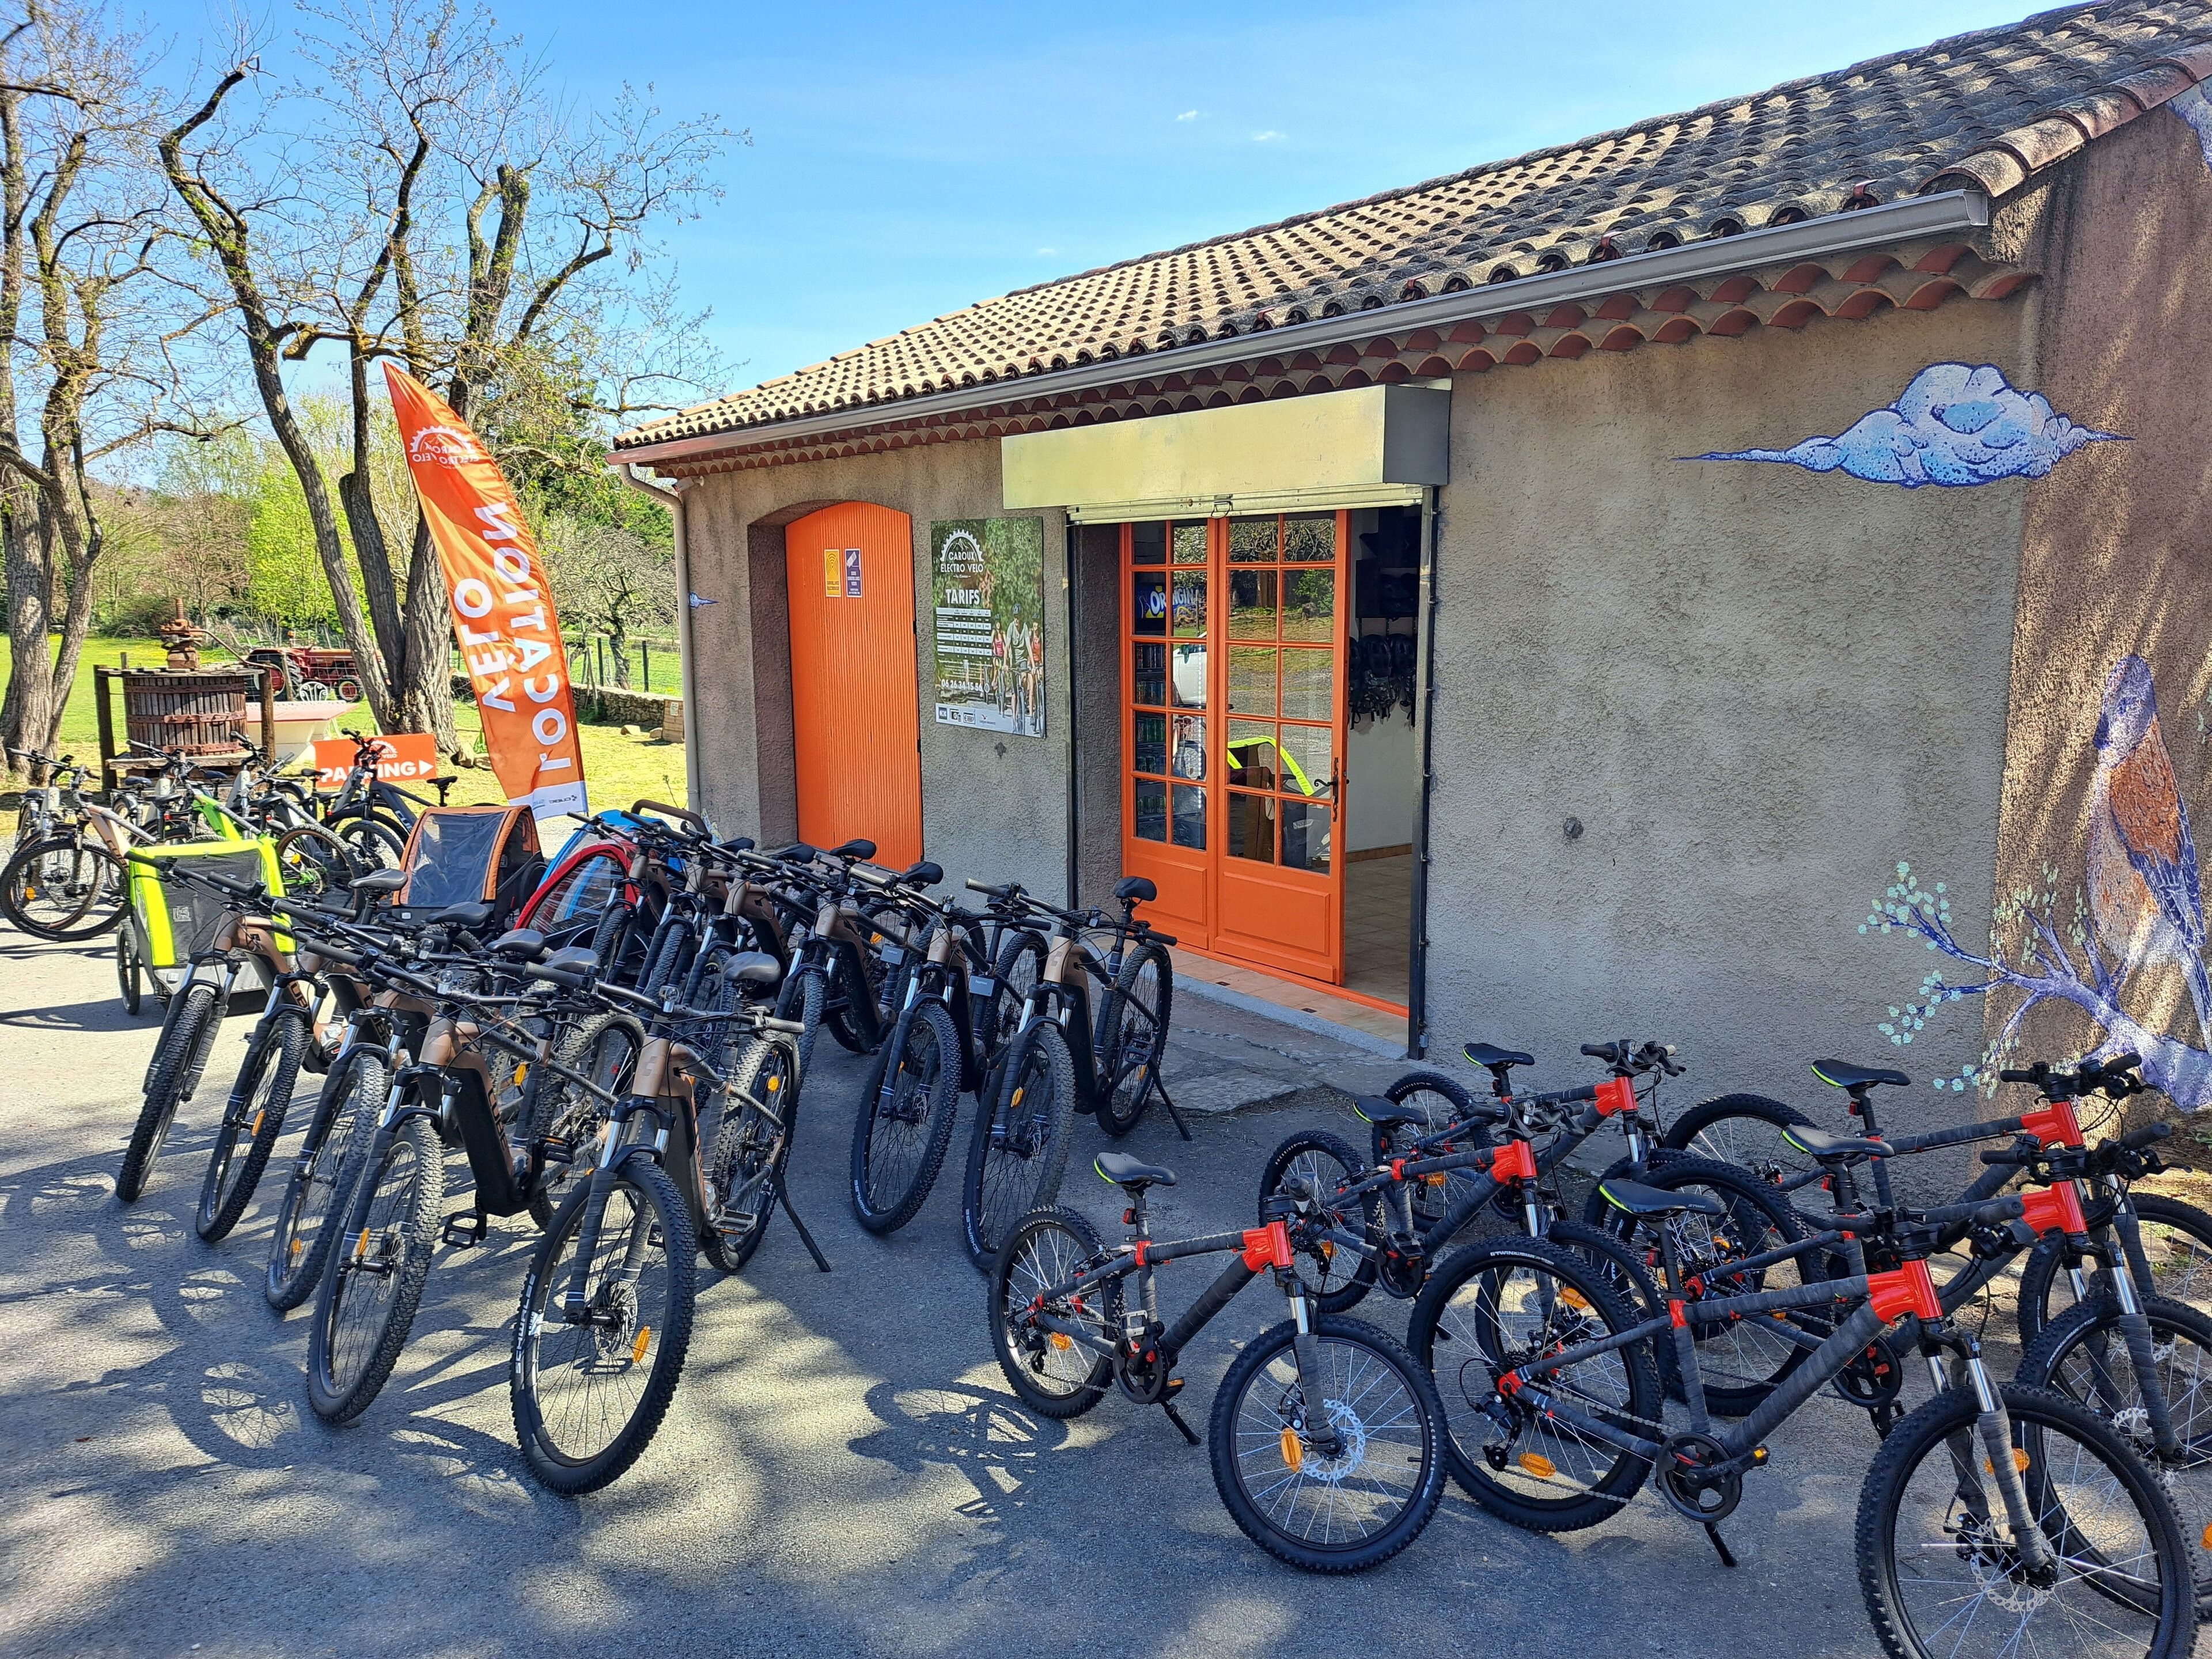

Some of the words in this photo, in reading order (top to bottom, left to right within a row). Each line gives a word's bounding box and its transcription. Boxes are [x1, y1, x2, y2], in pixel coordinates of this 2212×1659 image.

[949, 551, 976, 560] CAROUX
[941, 563, 965, 573] ELECTRO
[945, 589, 980, 605] TARIFS
[941, 679, 949, 687] 06
[950, 680, 957, 688] 26
[968, 681, 974, 691] 15
[320, 761, 416, 783] PAING
[1427, 1415, 1437, 1471] ROCKRIDER
